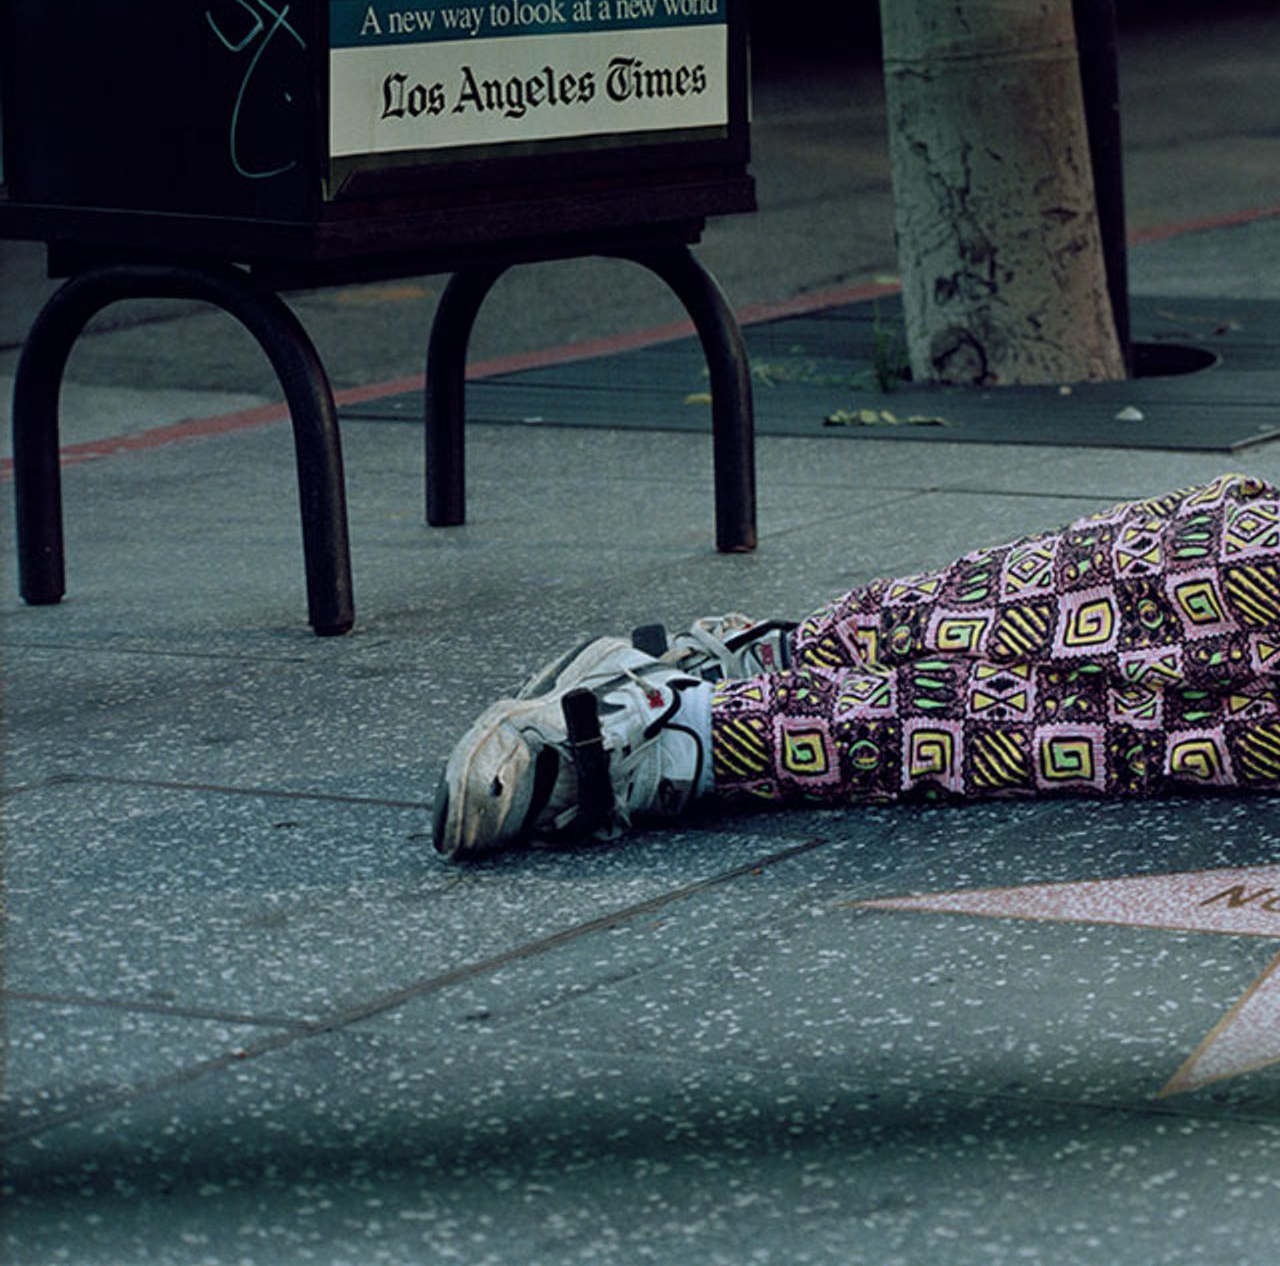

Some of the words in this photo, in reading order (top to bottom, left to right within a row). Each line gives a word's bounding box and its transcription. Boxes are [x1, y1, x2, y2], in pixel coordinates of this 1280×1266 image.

[361, 7, 382, 36] A
[389, 12, 437, 34] new
[441, 9, 484, 37] way
[490, 1, 510, 26] to
[573, 0, 593, 22] at
[599, 3, 611, 21] a
[616, 0, 658, 21] new
[380, 73, 445, 120] Los
[452, 65, 596, 119] Angeles
[605, 57, 707, 102] Times
